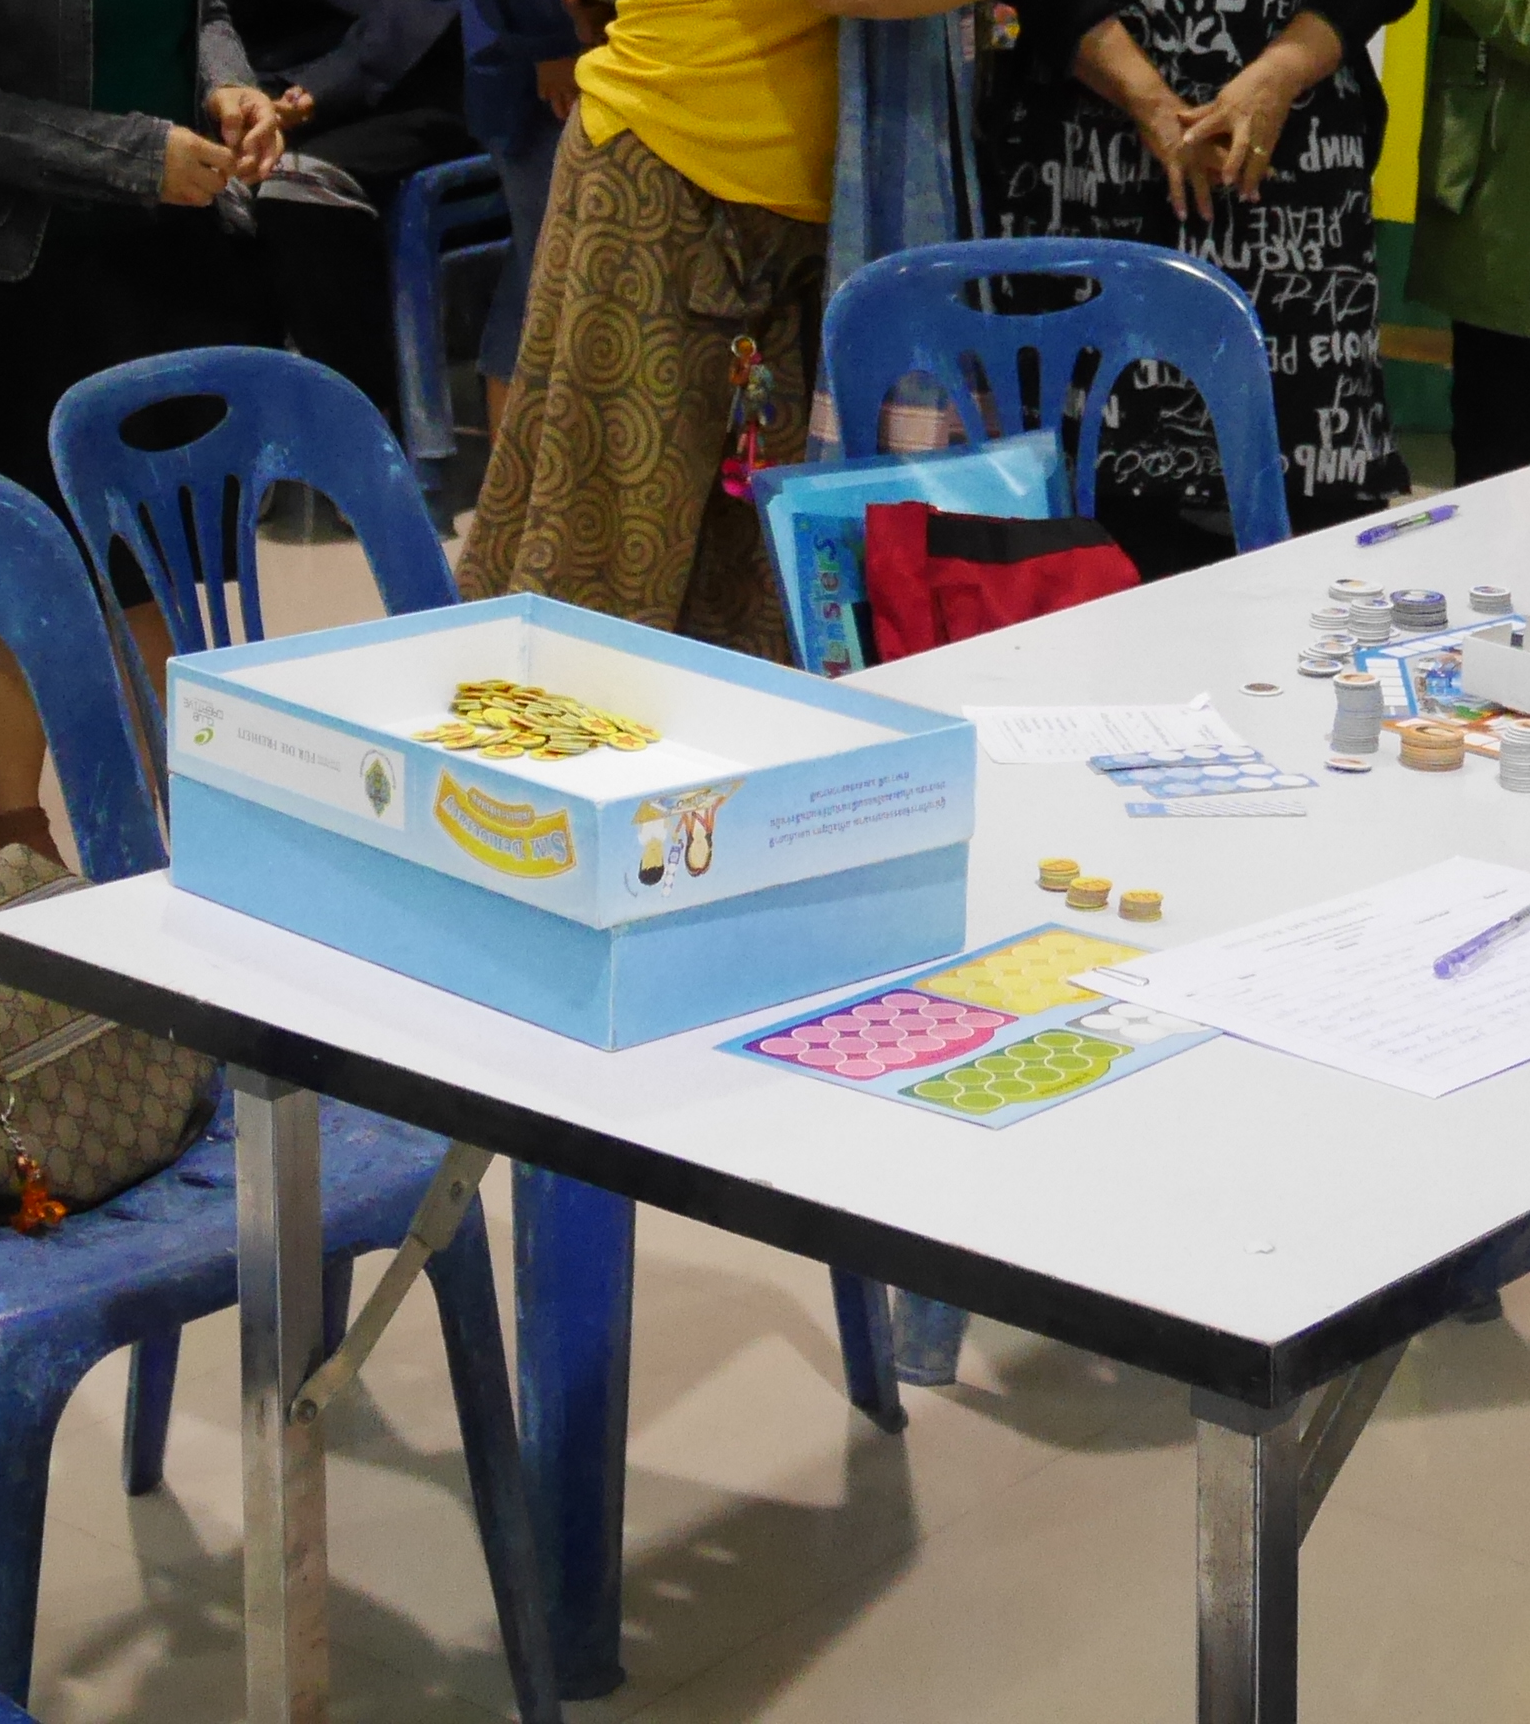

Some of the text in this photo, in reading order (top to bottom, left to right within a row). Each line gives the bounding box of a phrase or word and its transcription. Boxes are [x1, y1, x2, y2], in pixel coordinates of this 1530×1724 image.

[236, 727, 278, 752] FREIHEIT
[280, 741, 297, 758] DIE
[298, 747, 316, 766] FÜR
